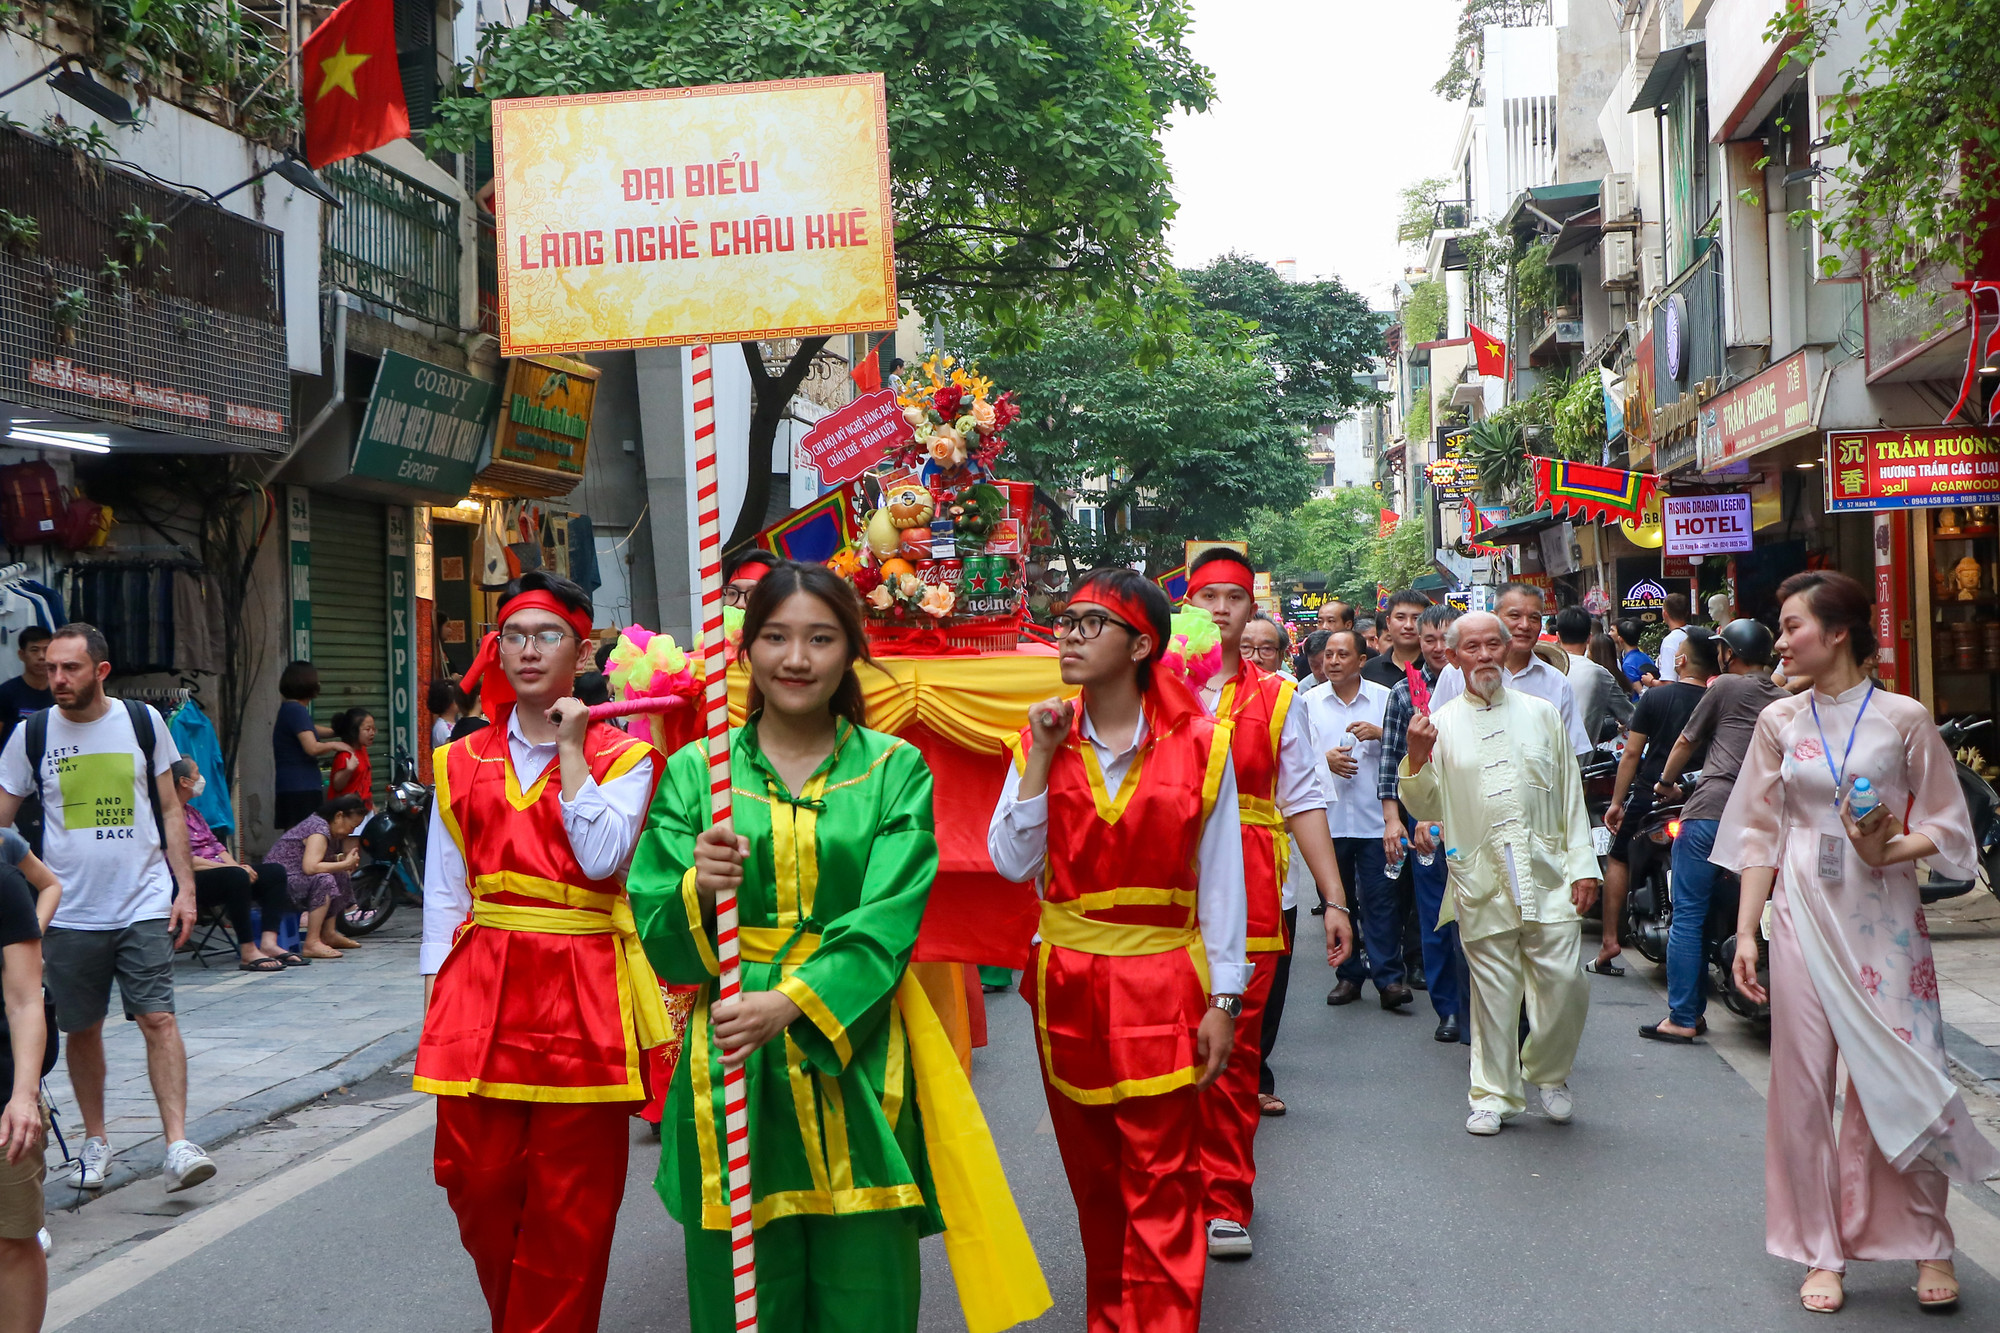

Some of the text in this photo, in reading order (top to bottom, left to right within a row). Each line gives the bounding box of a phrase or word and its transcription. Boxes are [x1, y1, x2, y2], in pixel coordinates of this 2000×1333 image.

[621, 152, 759, 206] ĐẠI BIỂU
[519, 207, 869, 270] LÀNG NGHỀ CHÂU KHÊ
[56, 359, 73, 389] 56
[414, 367, 472, 401] CORNY
[1746, 382, 1777, 426] HƯƠNG
[369, 389, 408, 446] HÀNG
[811, 441, 826, 456] CHI
[823, 433, 838, 450] HỘI
[862, 410, 883, 426] VÀNG
[879, 400, 896, 417] BẠC
[827, 450, 847, 468] CHÂU
[843, 440, 861, 459] KHÊ
[860, 430, 882, 449] HOÀN
[878, 419, 899, 439] KIẾM
[1875, 433, 1930, 460] TRẦM
[398, 459, 440, 482] EXPORT
[1432, 467, 1456, 476] FOOT
[1838, 439, 1866, 495] 沉香
[1880, 460, 1999, 479] HƯƠNG TRẦM CÁC LOẠI
[1432, 475, 1456, 484] BODY
[1880, 479, 1908, 496] العود
[1930, 479, 1999, 492] AGARWOOD
[1668, 498, 1746, 515] RISING DRAGON LEGEND
[1911, 497, 1928, 505] 0948
[1929, 496, 1941, 504] 458
[1942, 496, 1955, 504] 866
[1960, 495, 1977, 503] 0988
[1675, 515, 1743, 536] HOTEL
[1302, 593, 1321, 610] Coffee
[1450, 599, 1468, 611] SPA
[1622, 599, 1646, 607] PIZZA
[1878, 573, 1890, 638] 沉香
[46, 745, 80, 759] LET'S
[47, 757, 69, 767] RUN
[49, 764, 78, 776] AWAY
[95, 797, 122, 806] AND
[95, 808, 134, 817] NEVER
[95, 817, 127, 826] LOOK
[95, 828, 134, 840] BACK
